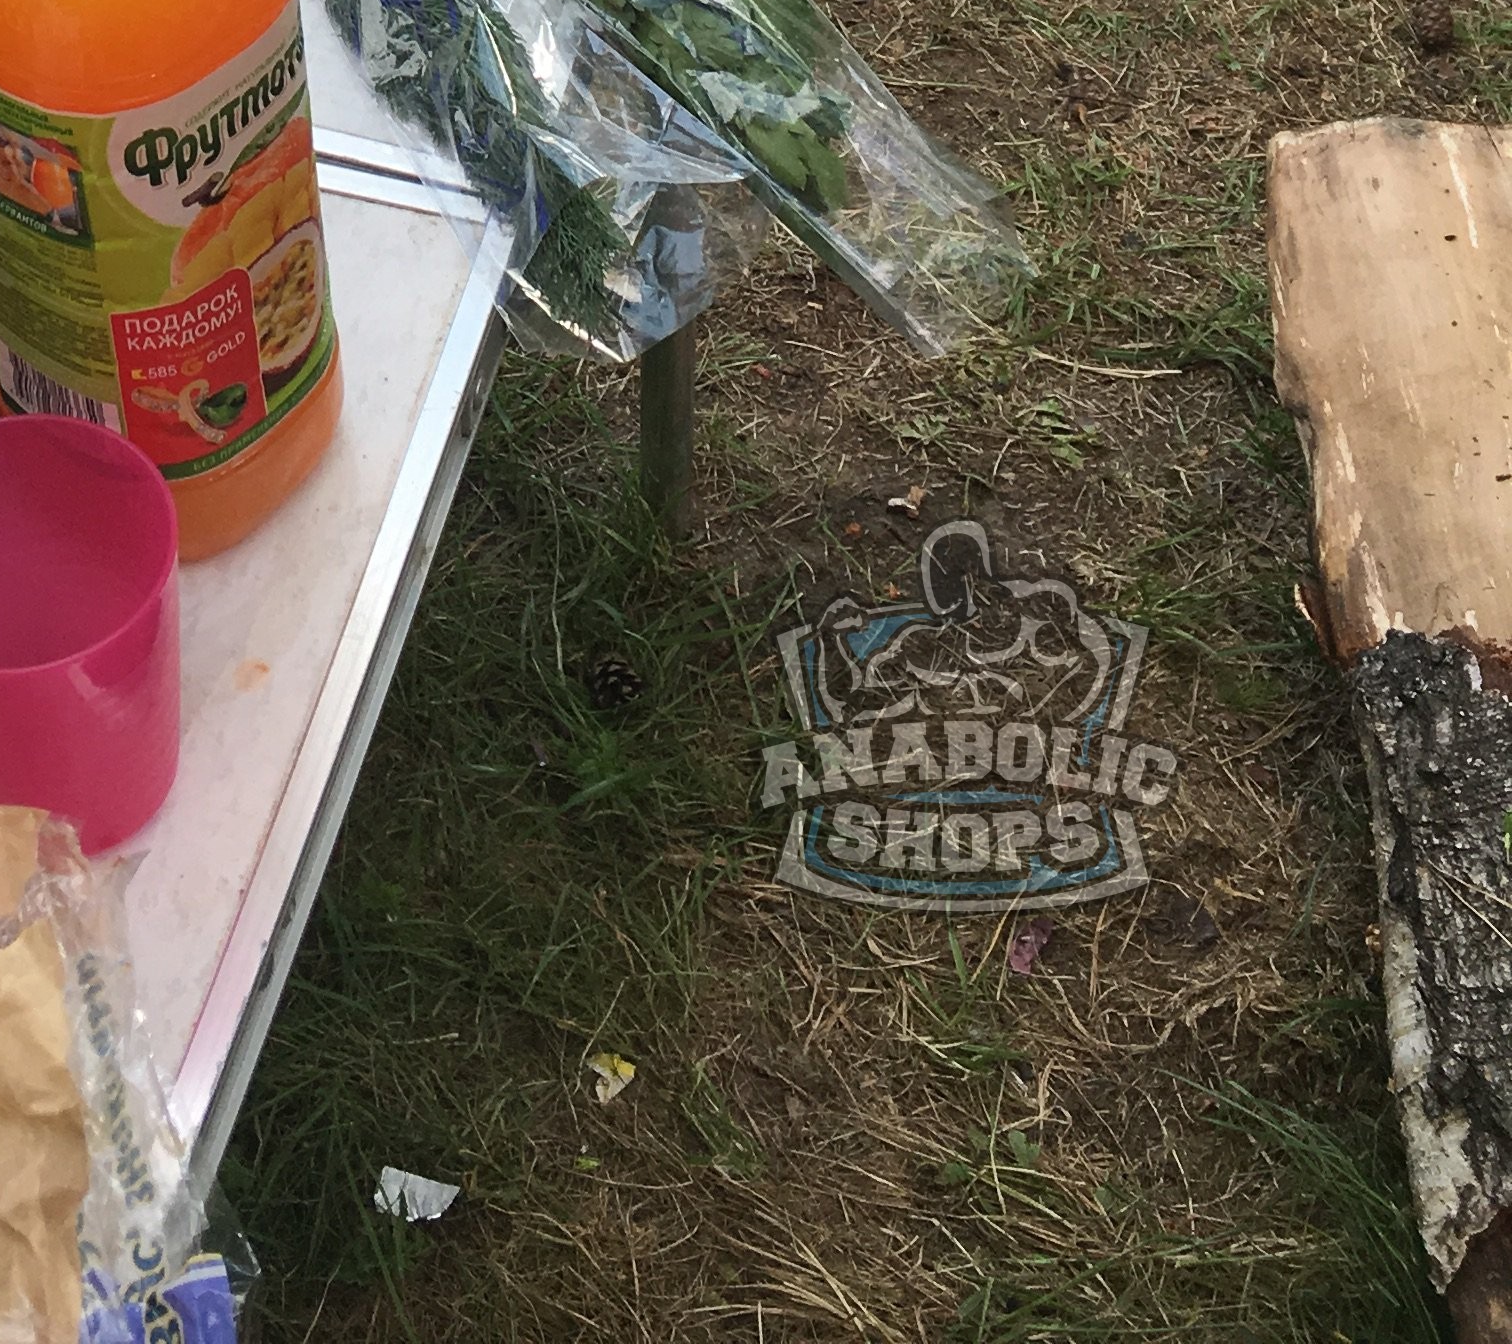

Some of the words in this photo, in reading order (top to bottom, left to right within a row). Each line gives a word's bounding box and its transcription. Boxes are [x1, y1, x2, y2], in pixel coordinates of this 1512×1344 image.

[124, 284, 239, 334] ПОДАРОК
[127, 300, 243, 352] КАЖДОМУ!
[148, 365, 178, 380] 585
[206, 331, 246, 364] GOLD
